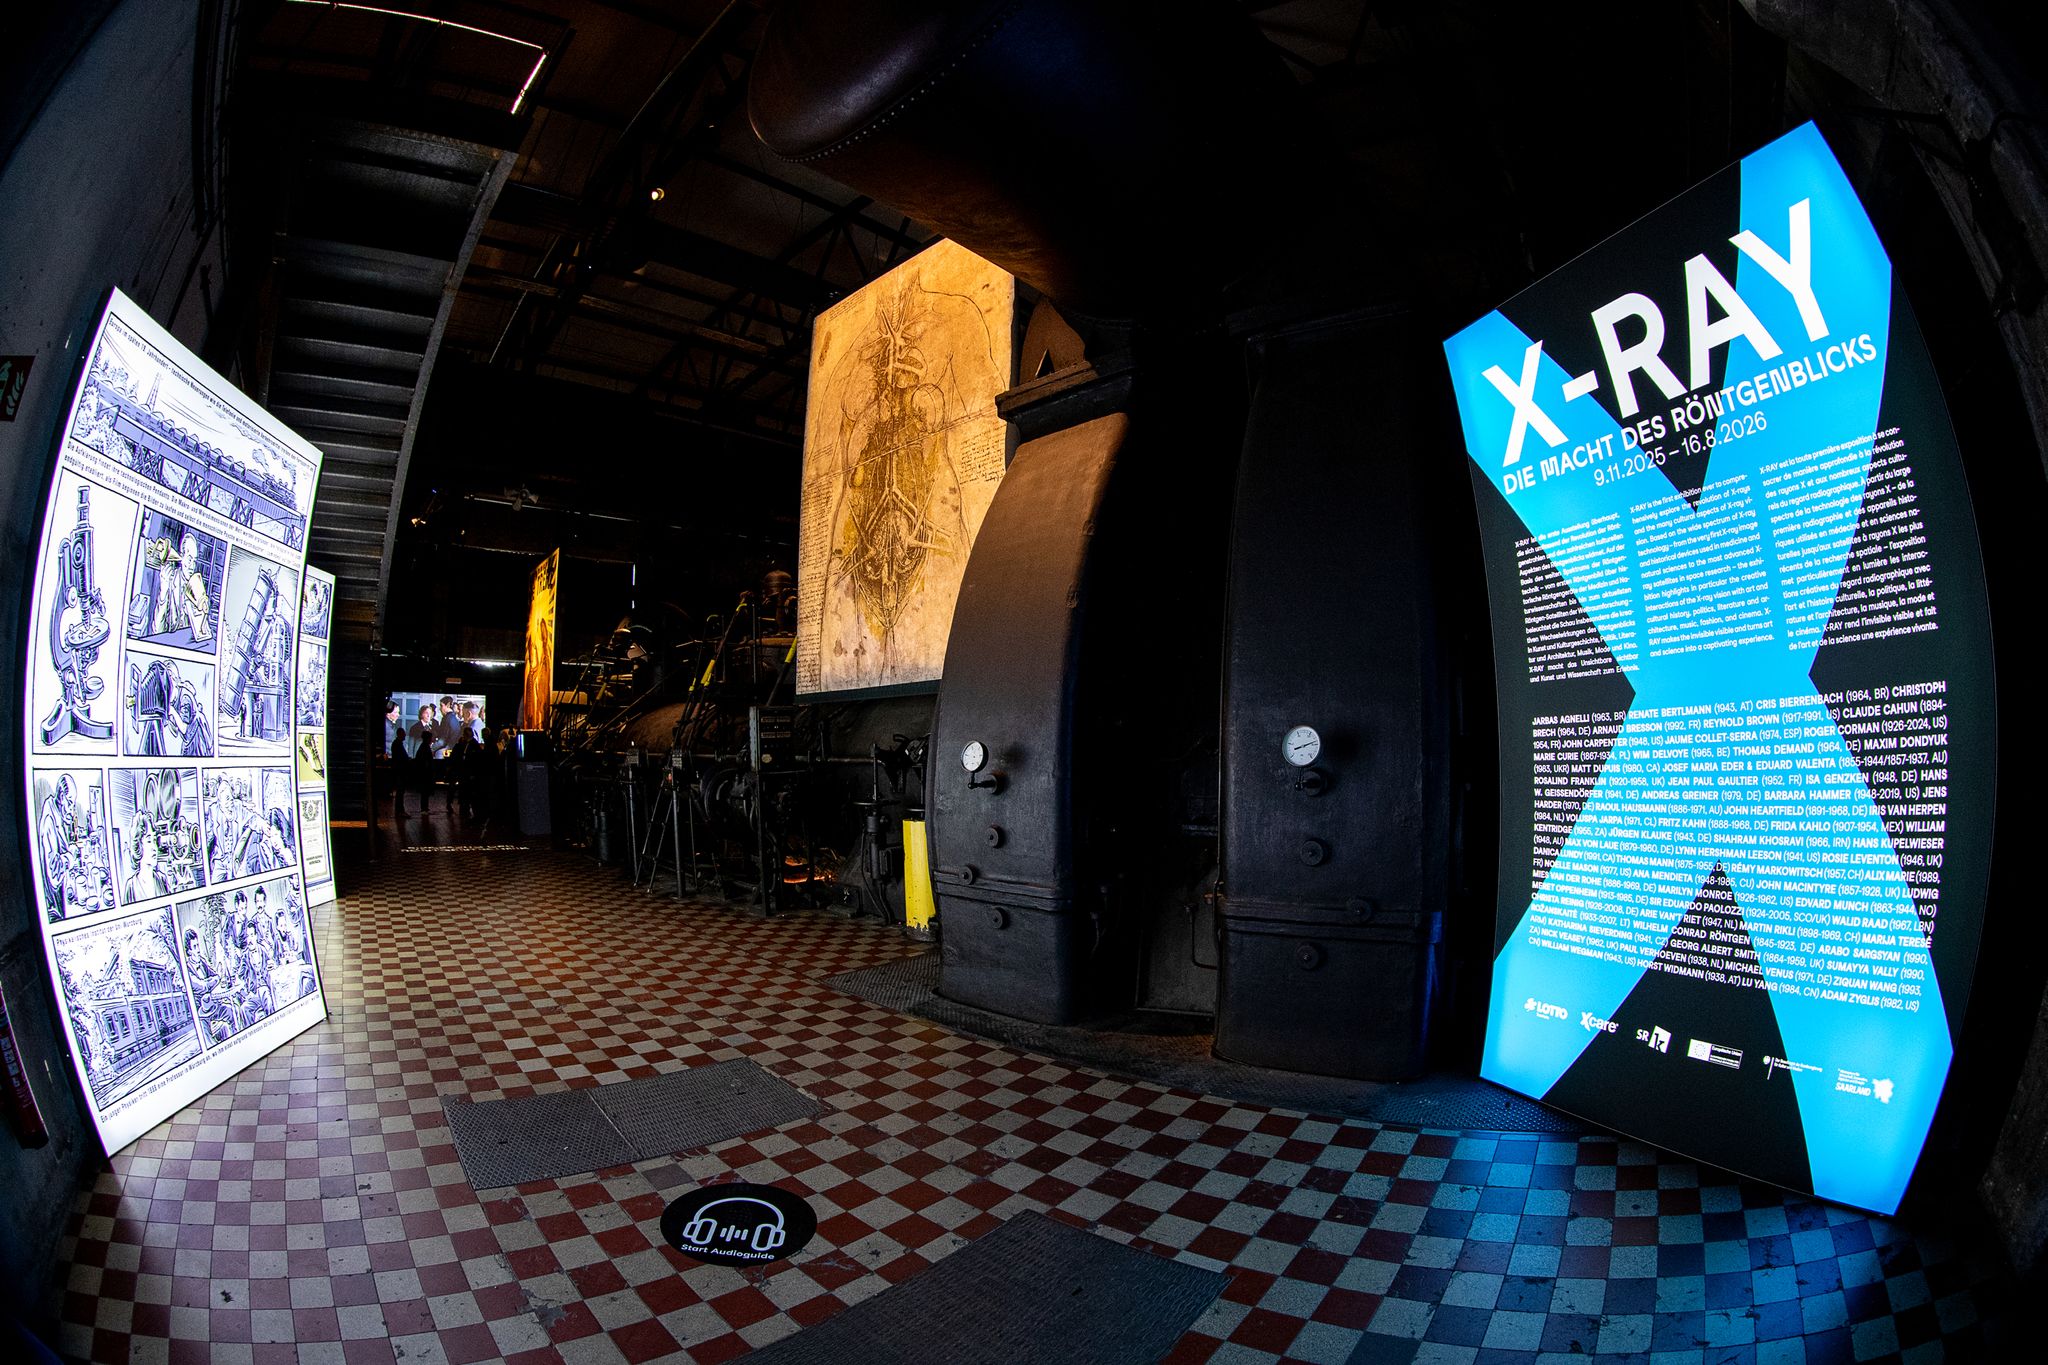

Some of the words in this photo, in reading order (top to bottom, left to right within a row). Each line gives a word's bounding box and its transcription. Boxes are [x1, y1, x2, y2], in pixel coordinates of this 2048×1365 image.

[1482, 197, 1829, 466] X-RAY
[1503, 465, 1536, 494] DIE
[1540, 434, 1614, 480] MACHT
[1623, 415, 1666, 450] DES
[1671, 333, 1877, 432] RÖNTGENBLICKS
[1593, 450, 1666, 487] 9.11.2025
[1681, 411, 1767, 455] 16.8.2026
[1772, 523, 1801, 537] première
[1802, 512, 1843, 528] radiographie
[1844, 510, 1852, 518] et
[1853, 507, 1866, 516] des
[1867, 498, 1897, 513] appareils
[1897, 494, 1917, 504] histo-
[1781, 577, 1794, 586] met
[1796, 565, 1850, 584] particulièrement
[1851, 564, 1861, 572] en
[1862, 558, 1888, 570] lumière
[1889, 556, 1900, 564] les
[1901, 550, 1928, 561] interac-
[1795, 627, 1821, 636] cinéma.
[1823, 621, 1843, 632] X-RAY
[1844, 618, 1860, 629] rend
[1893, 610, 1914, 621] visible
[1915, 608, 1924, 617] et
[1924, 606, 1937, 616] fait
[1649, 649, 1662, 657] and
[1661, 647, 1684, 655] science
[1703, 639, 1738, 650] captivating
[1738, 634, 1774, 645] experience.
[1740, 700, 1754, 712] AT)
[1755, 699, 1777, 710] CRIS
[1779, 692, 1843, 708] BIERRENBACH
[1845, 689, 1872, 703] (1964,
[1874, 686, 1890, 699] BR)
[1892, 680, 1946, 697] CHRISTOPH
[1746, 714, 1779, 726] BROWN
[1782, 710, 1824, 725] (1917-1991,
[1826, 707, 1840, 721] US)
[1842, 705, 1881, 718] CLAUDE
[1883, 701, 1918, 715] CAHUN
[1919, 698, 1947, 713] (1894-
[1694, 731, 1758, 743] COLLET-SERRA
[1759, 729, 1782, 741] (1974,
[1783, 727, 1802, 739] ESP)
[1803, 725, 1836, 737] ROGER
[1837, 722, 1880, 735] CORMAN
[1881, 717, 1931, 733] (1926-2024,
[1932, 715, 1948, 728] US)
[1733, 745, 1771, 756] THOMAS
[1774, 742, 1814, 754] DEMAND
[1817, 741, 1842, 754] (1964,
[1845, 738, 1861, 752] DE)
[1864, 737, 1897, 750] MAXIM
[1900, 733, 1948, 748] DONDYUK
[1747, 761, 1752, 770] &
[1756, 759, 1793, 770] EDUARD
[1795, 757, 1836, 769] VALENTA
[1838, 752, 1929, 769] (1855-1944/1857-1937,
[1931, 750, 1948, 764] AU)
[1741, 977, 1753, 987] LU
[1754, 979, 1778, 991] YANG
[1779, 982, 1801, 995] (1984,
[1803, 987, 1820, 999] CN)
[1820, 989, 1847, 1001] ADAM
[1848, 993, 1880, 1006] ZYGLIS
[1880, 996, 1903, 1010] (1982,
[1905, 1000, 1920, 1012] US)
[1537, 1001, 1568, 1020] LOTTO
[1580, 1012, 1618, 1034] Xcare
[1636, 1029, 1650, 1042] SR
[1835, 1082, 1871, 1096] SAARLAND
[681, 1243, 708, 1253] Start
[711, 1248, 775, 1259] Audioguide
